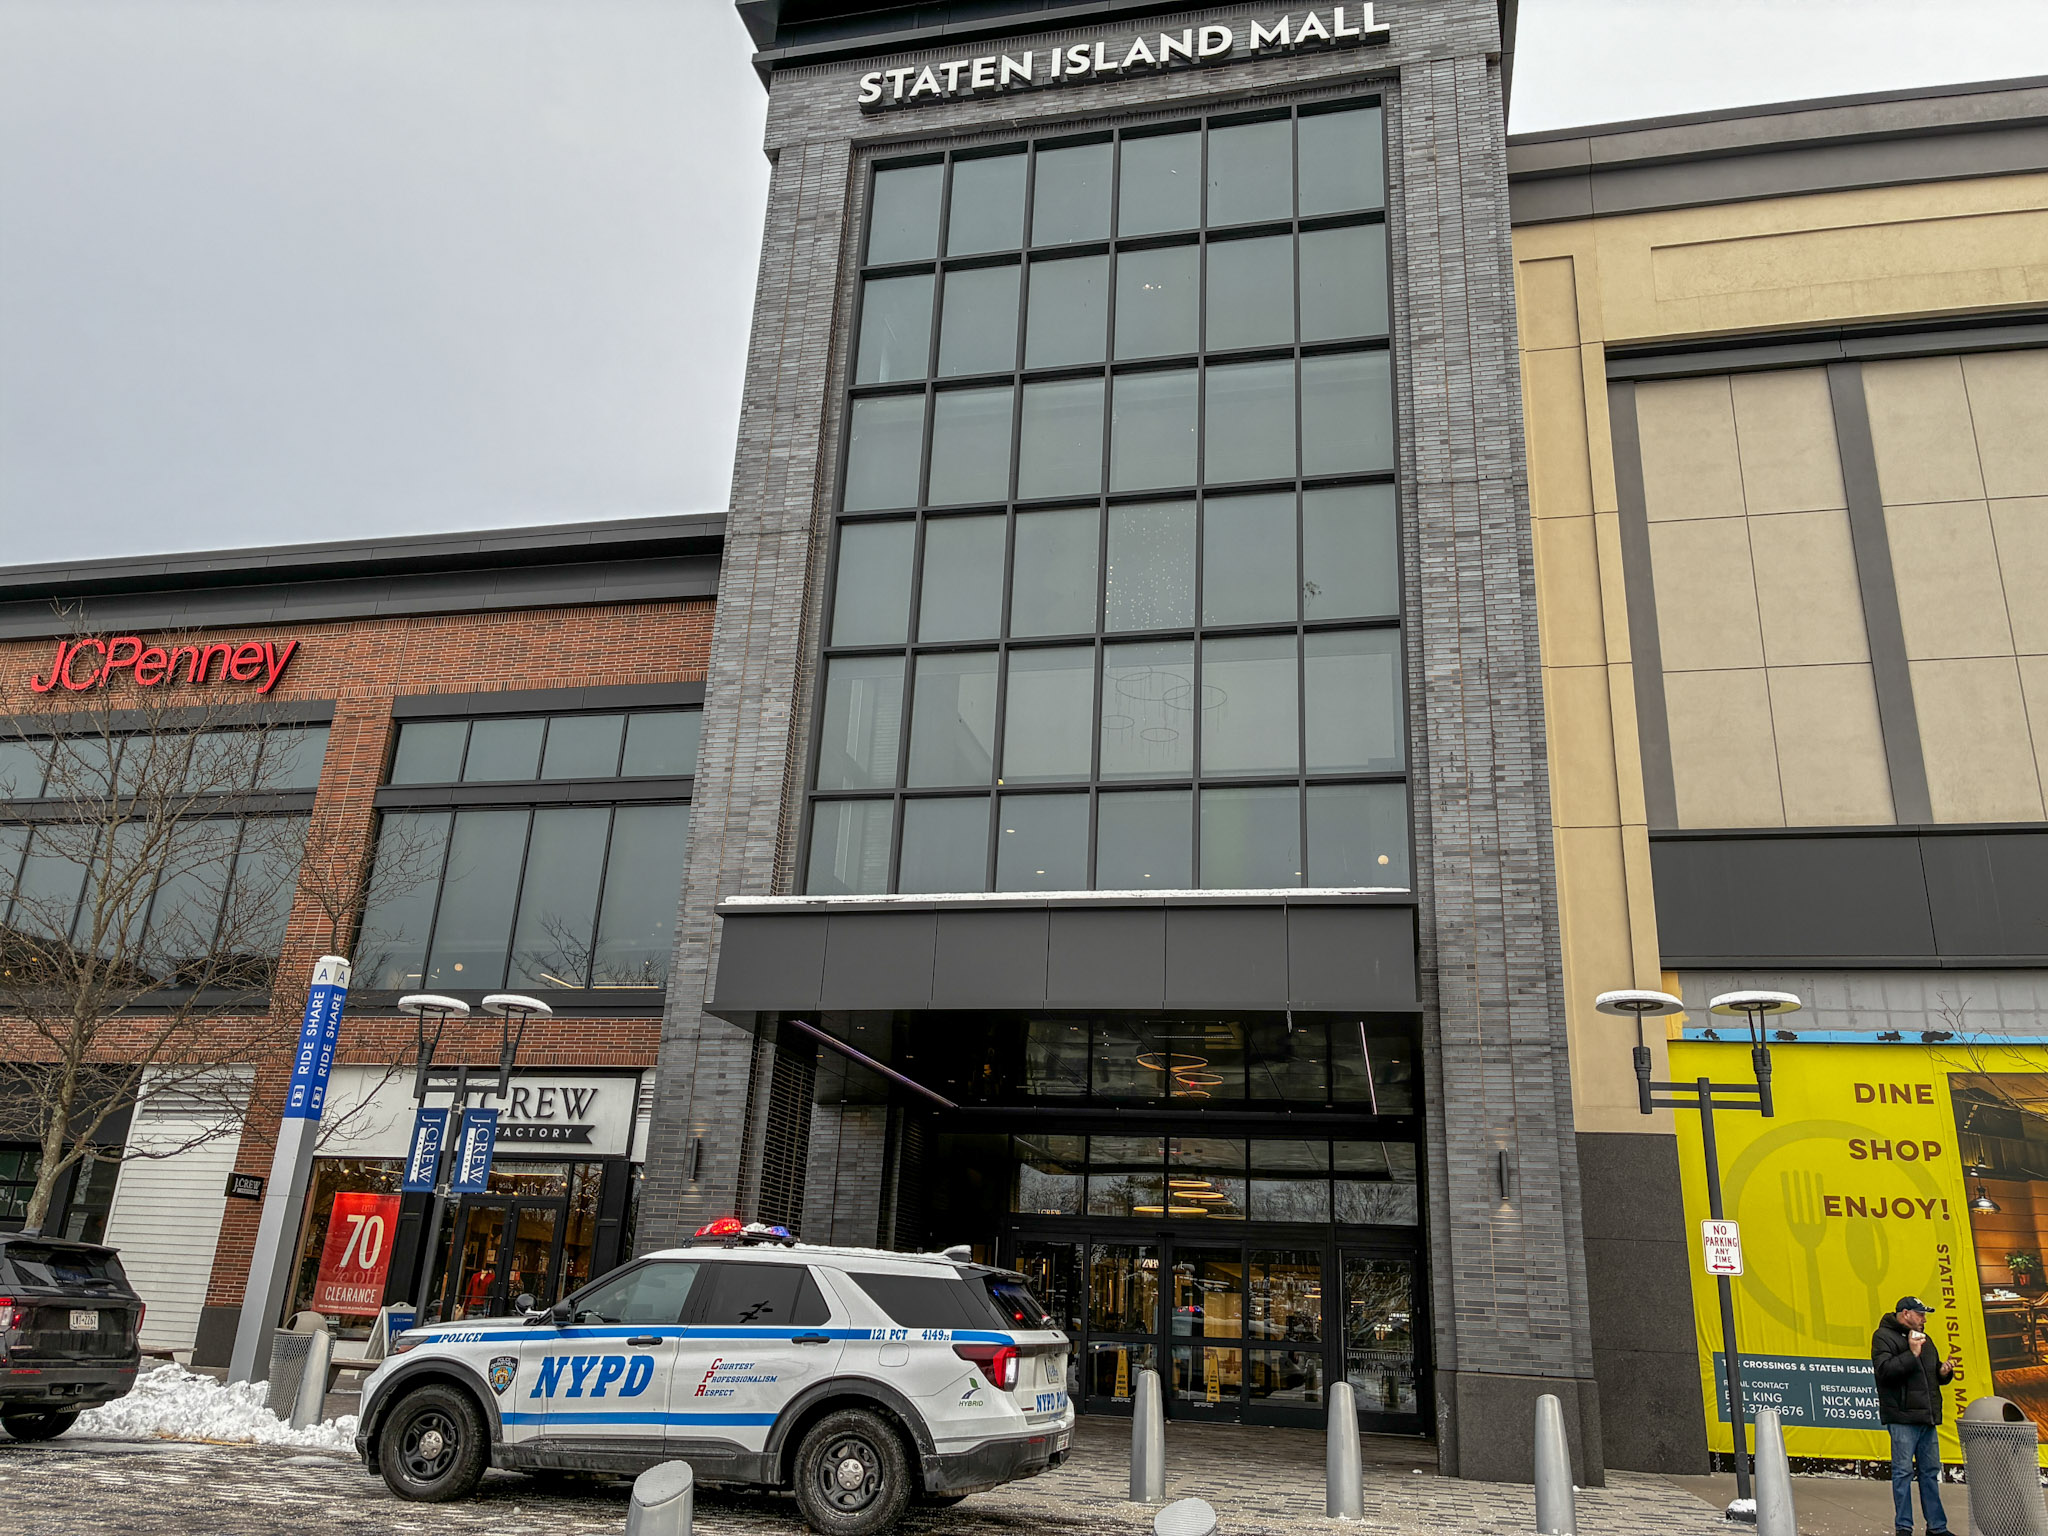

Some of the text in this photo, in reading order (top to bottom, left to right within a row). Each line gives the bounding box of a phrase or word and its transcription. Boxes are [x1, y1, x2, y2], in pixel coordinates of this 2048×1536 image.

[857, 2, 1390, 103] STATEN ISLAND MALL
[30, 636, 299, 694] JCPenney
[318, 967, 328, 981] A
[337, 970, 345, 984] A
[298, 991, 325, 1075] RIDE SHARE
[317, 993, 343, 1077] RIDE SHARE
[1854, 1083, 1934, 1105] DINE
[495, 1127, 573, 1139] FACTORY
[418, 1116, 441, 1184] J.CREW
[468, 1115, 491, 1184] J.CREW
[1848, 1138, 1942, 1162] SHOP
[1823, 1195, 1950, 1221] ENJOY!
[1713, 1225, 1727, 1236] NO
[339, 1214, 385, 1270] 70
[1705, 1236, 1738, 1248] PARKING
[1715, 1247, 1730, 1255] ANY
[1714, 1255, 1733, 1263] TIME
[1936, 1243, 1957, 1309] STATEN
[325, 1286, 377, 1303] CLEARANCE
[439, 1332, 483, 1343] POLICE
[871, 1329, 886, 1341] 121
[889, 1329, 908, 1341] PCT
[710, 1358, 755, 1370] COURTESY
[1743, 1360, 1797, 1371] CROSSINGS
[1800, 1363, 1807, 1371] &
[1809, 1363, 1844, 1373] STATEN
[529, 1355, 655, 1399] NYPD
[702, 1371, 777, 1383] PROFESSIONALISM
[694, 1384, 734, 1397] RESPECT
[1751, 1381, 1790, 1390] CONTACT
[1820, 1384, 1873, 1394] RESTAURANT
[1036, 1393, 1055, 1413] NYPD
[1753, 1391, 1783, 1403] KING
[1822, 1395, 1852, 1407] NICK
